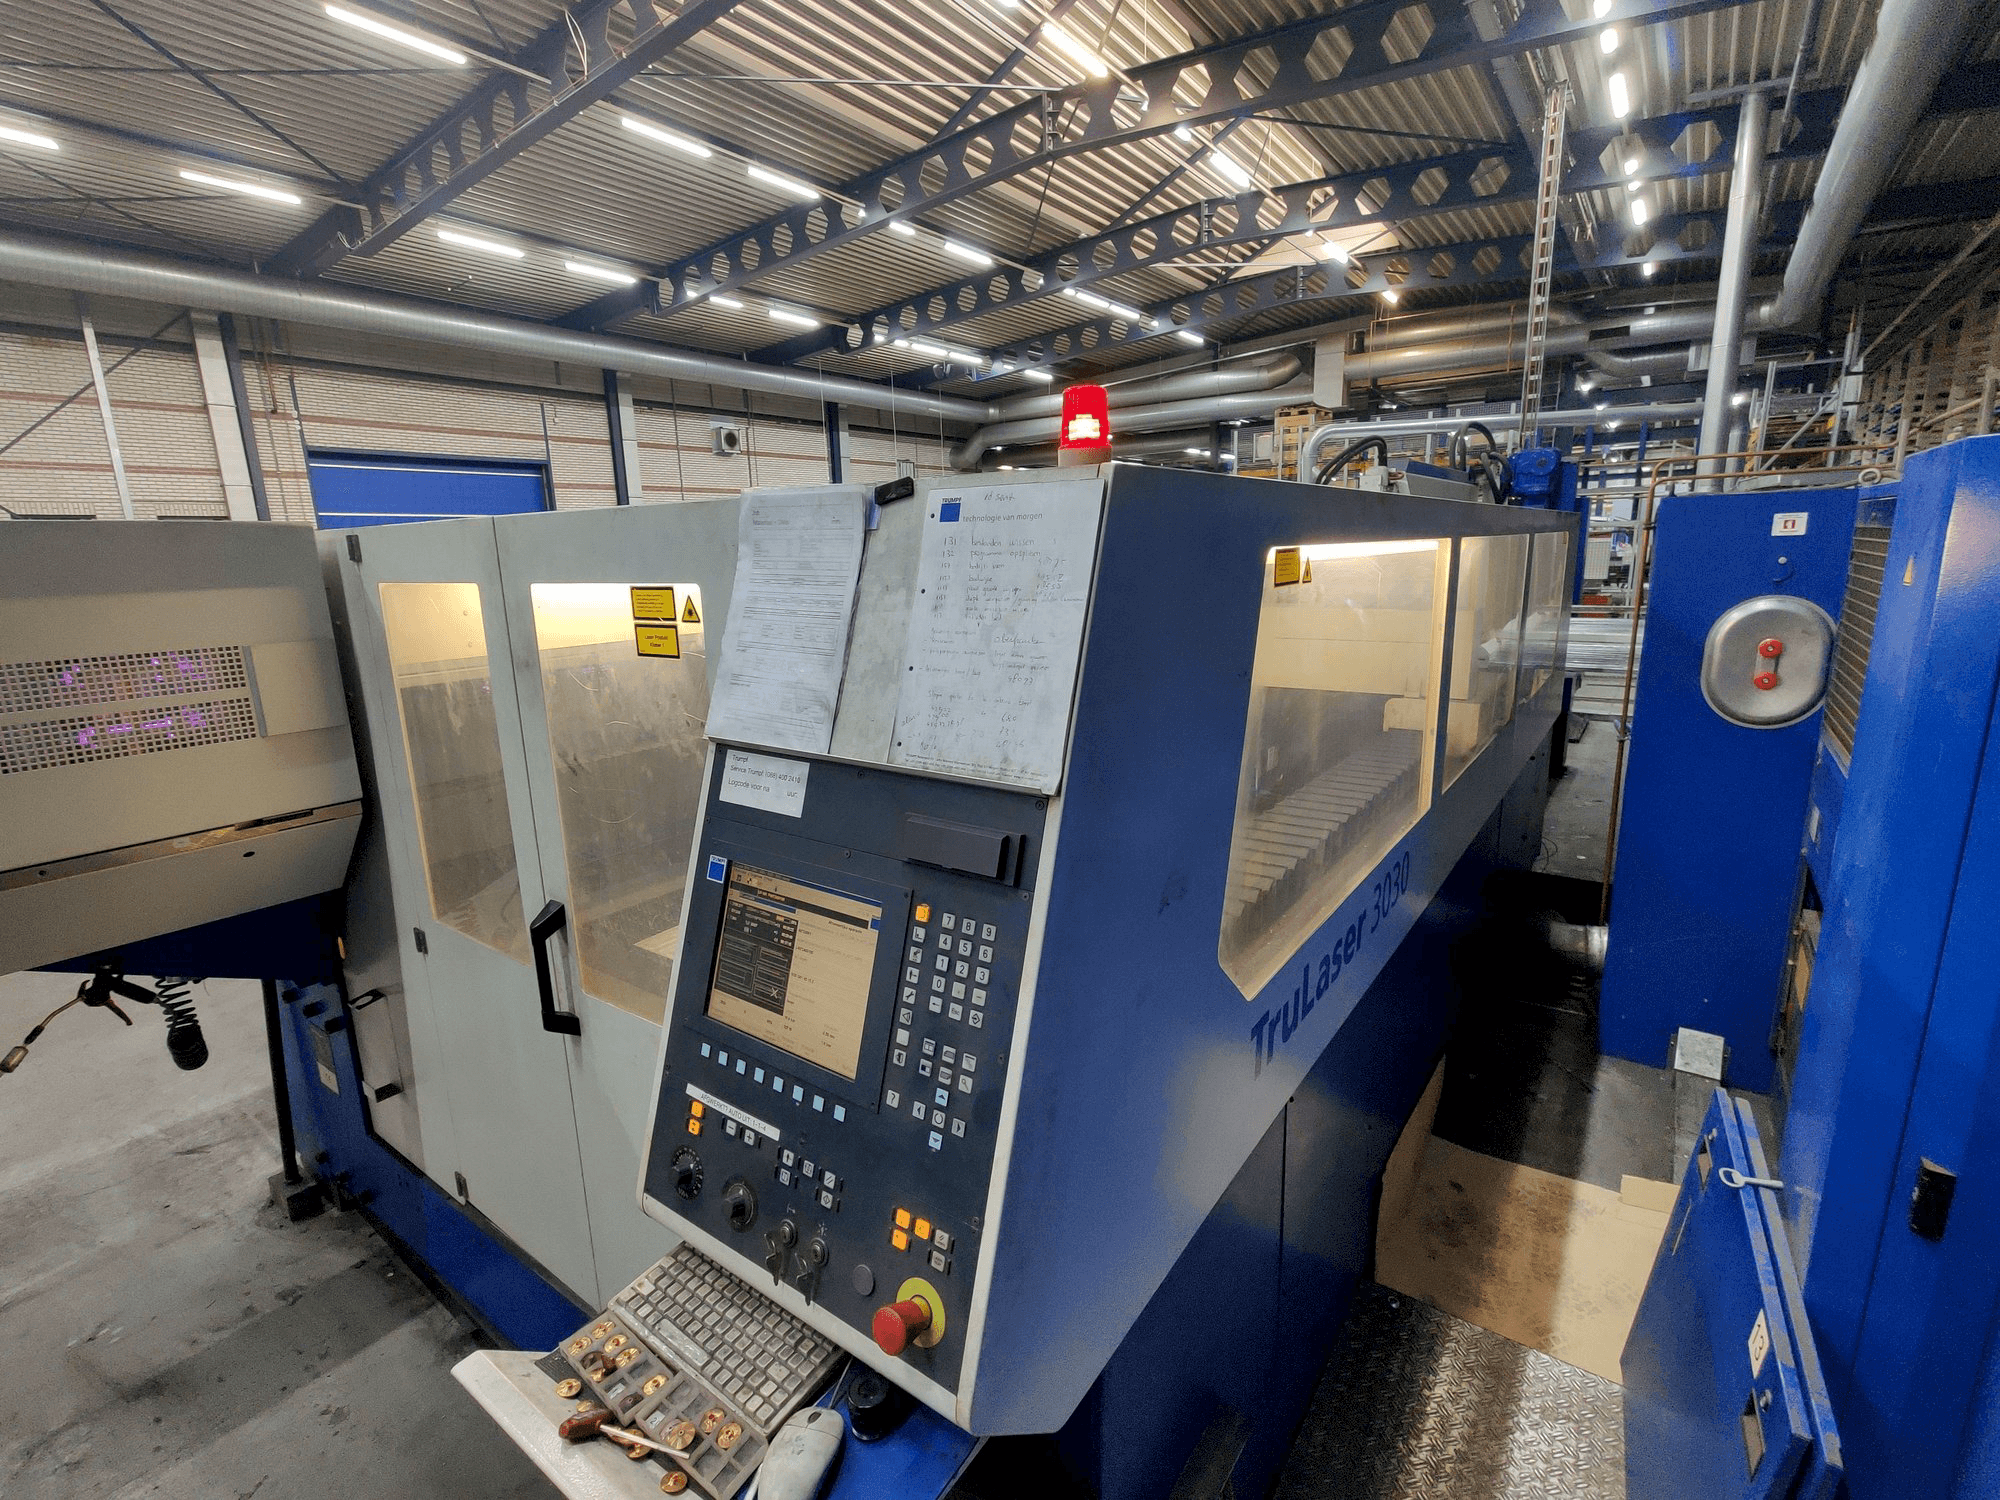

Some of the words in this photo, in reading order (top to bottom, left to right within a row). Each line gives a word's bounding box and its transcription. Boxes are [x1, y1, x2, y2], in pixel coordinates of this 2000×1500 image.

[962, 514, 1000, 523] technologie
[1016, 513, 1043, 521] morgen
[732, 754, 749, 763] Trumpf
[730, 765, 746, 774] Service
[728, 777, 749, 788] Logcode
[1250, 909, 1366, 1081] TruLaser
[1370, 851, 1410, 934] 3030
[729, 1108, 742, 1120] AUTO
[1752, 1323, 1765, 1361] 13
